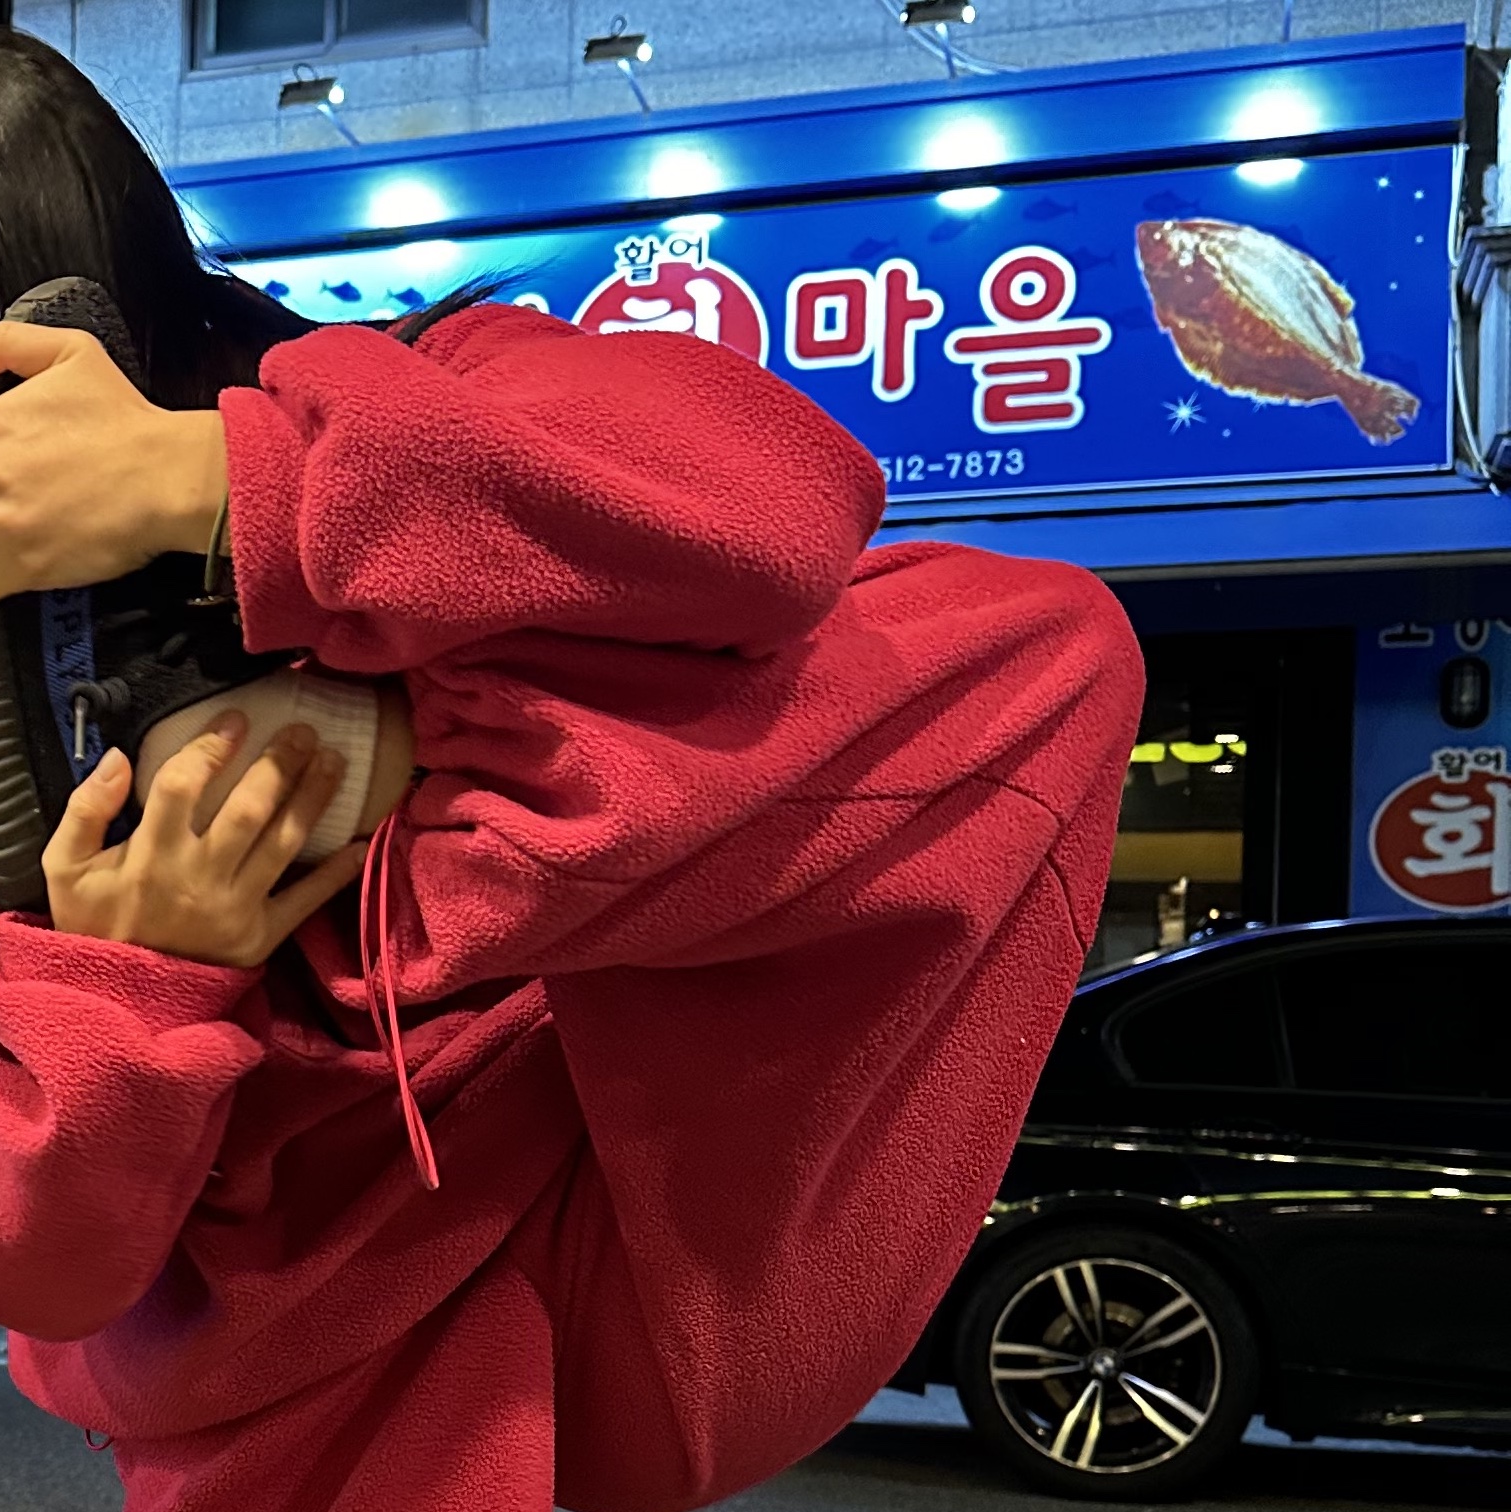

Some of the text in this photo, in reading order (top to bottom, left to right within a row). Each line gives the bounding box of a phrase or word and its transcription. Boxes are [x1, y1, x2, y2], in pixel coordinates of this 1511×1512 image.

[620, 236, 704, 282] 활어
[790, 250, 1108, 430] 마을
[1437, 751, 1502, 778] 활어
[1402, 780, 1511, 896] 회
